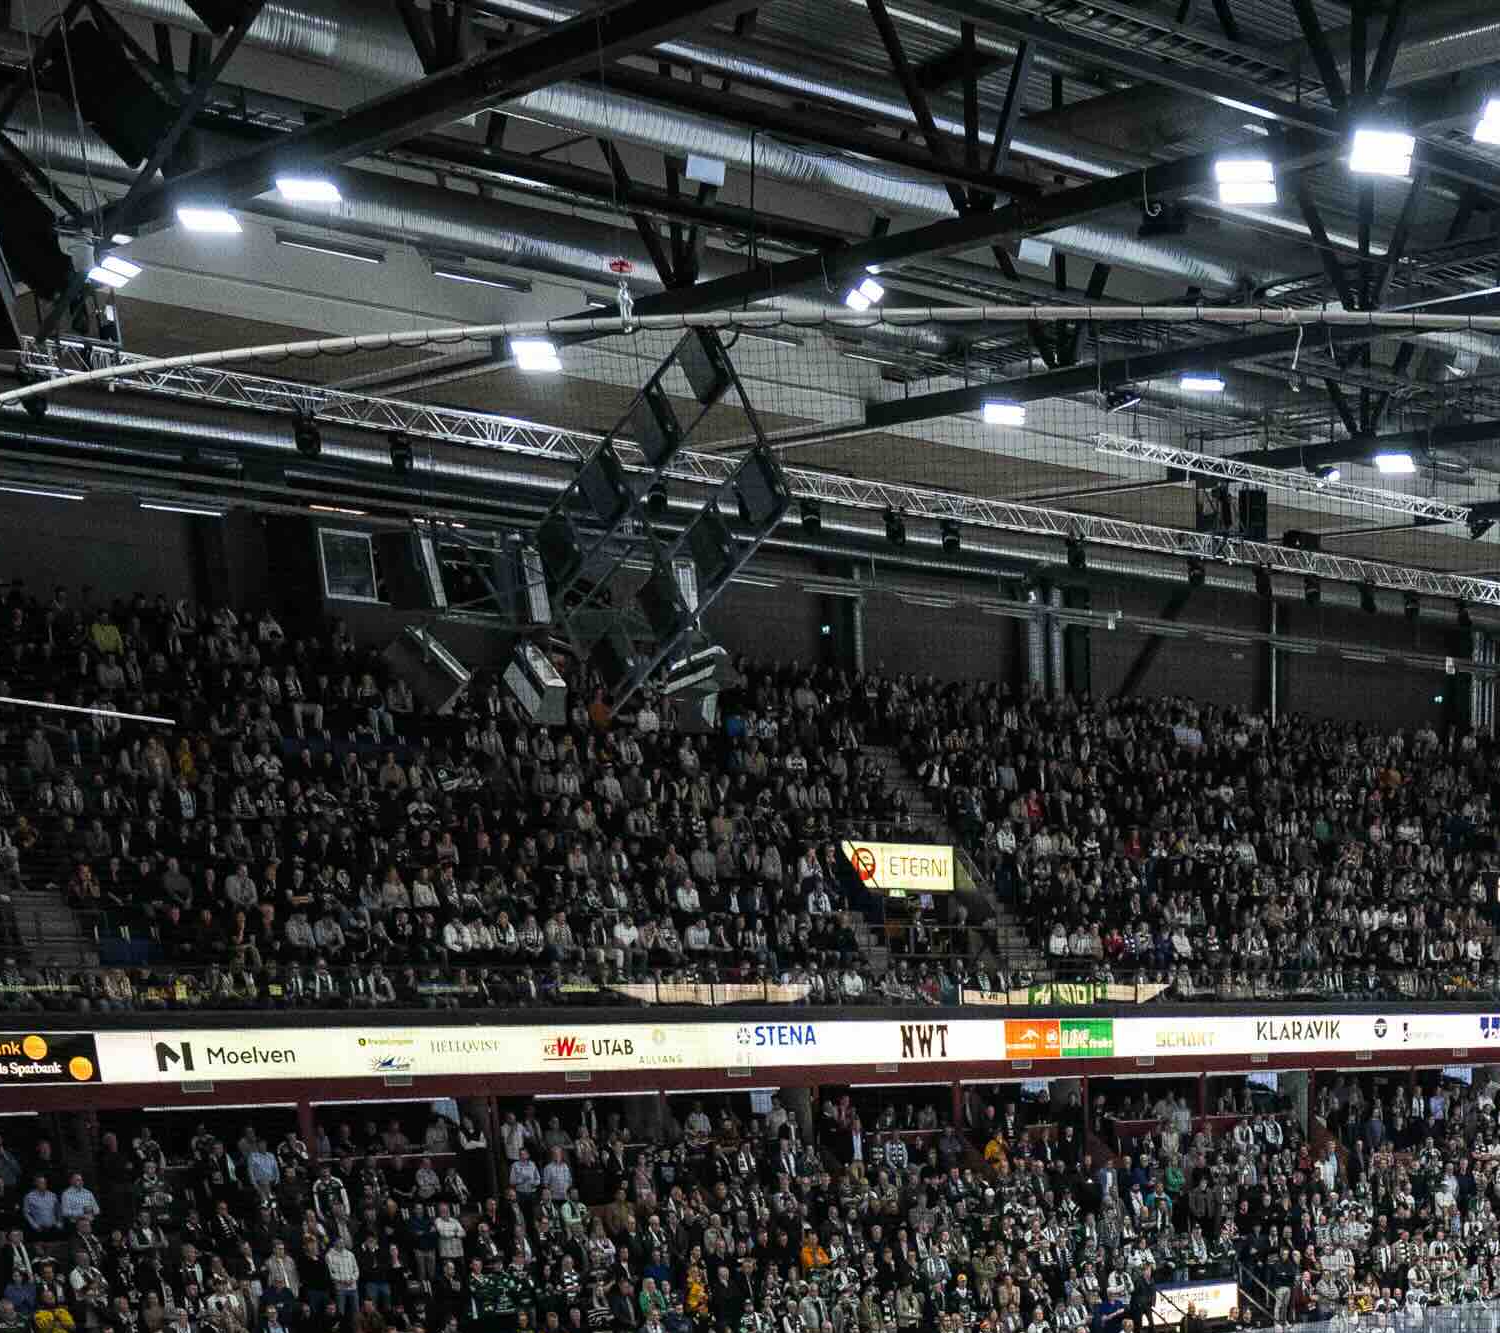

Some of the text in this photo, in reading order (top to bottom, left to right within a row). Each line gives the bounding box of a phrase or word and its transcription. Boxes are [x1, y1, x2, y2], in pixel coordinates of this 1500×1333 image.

[754, 1024, 817, 1047] STENA
[900, 1024, 949, 1058] NWT
[1256, 1018, 1342, 1042] KLARAVIK
[206, 1045, 297, 1067] Moelven
[591, 1039, 635, 1057] UTAB
[9, 1061, 63, 1077] Sparbank
